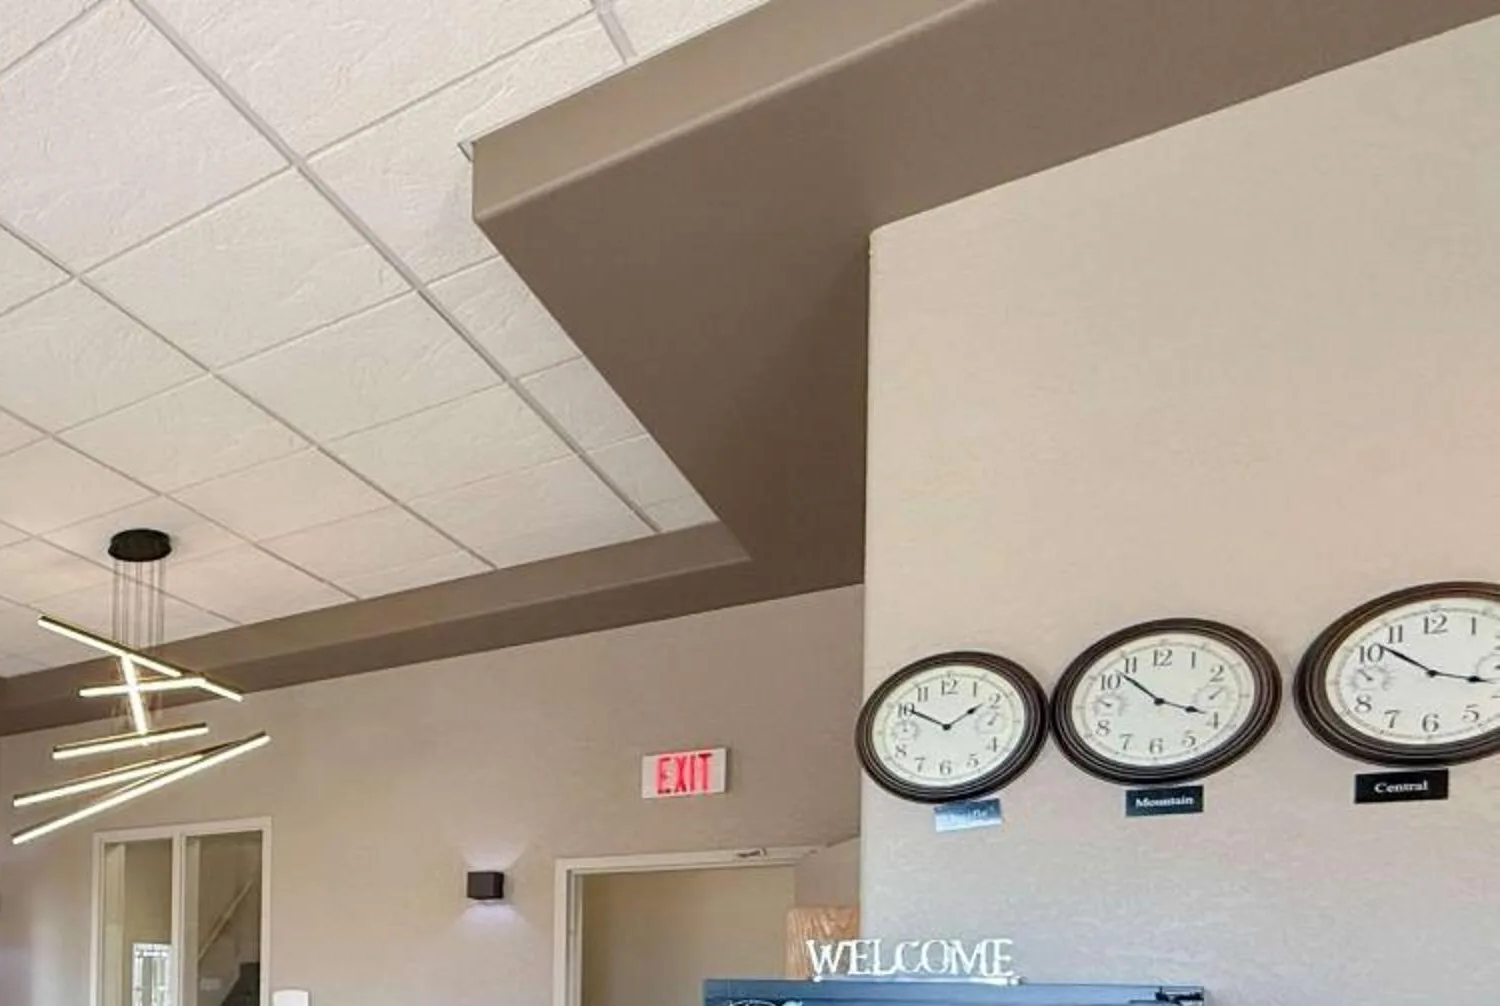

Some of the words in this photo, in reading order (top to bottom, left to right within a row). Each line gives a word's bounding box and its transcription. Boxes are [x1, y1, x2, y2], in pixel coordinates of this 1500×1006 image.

[1388, 625, 1404, 643] 11
[1423, 615, 1448, 635] 12
[1152, 649, 1173, 667] 12
[1359, 643, 1385, 663] 10
[1124, 656, 1138, 674] 11
[1210, 665, 1225, 683] 2
[941, 679, 960, 697] 12
[1100, 674, 1122, 691] 10
[917, 686, 929, 703] 11
[989, 693, 1001, 710] 2
[1354, 693, 1372, 713] 8
[1206, 712, 1219, 729] 4
[1384, 709, 1400, 729] 7
[1422, 713, 1439, 732] 6
[1462, 704, 1480, 723] 5
[1095, 720, 1110, 736] 8
[986, 736, 998, 753] 4
[1119, 733, 1133, 751] 7
[1149, 738, 1164, 754] 6
[1181, 730, 1196, 747] 5
[915, 757, 926, 772] 7
[939, 760, 952, 775] 6
[966, 753, 979, 768] 5
[656, 752, 712, 794] EXIT
[1373, 780, 1429, 793] Central
[1135, 795, 1195, 808] Mountain
[806, 938, 1014, 977] WELCOME
